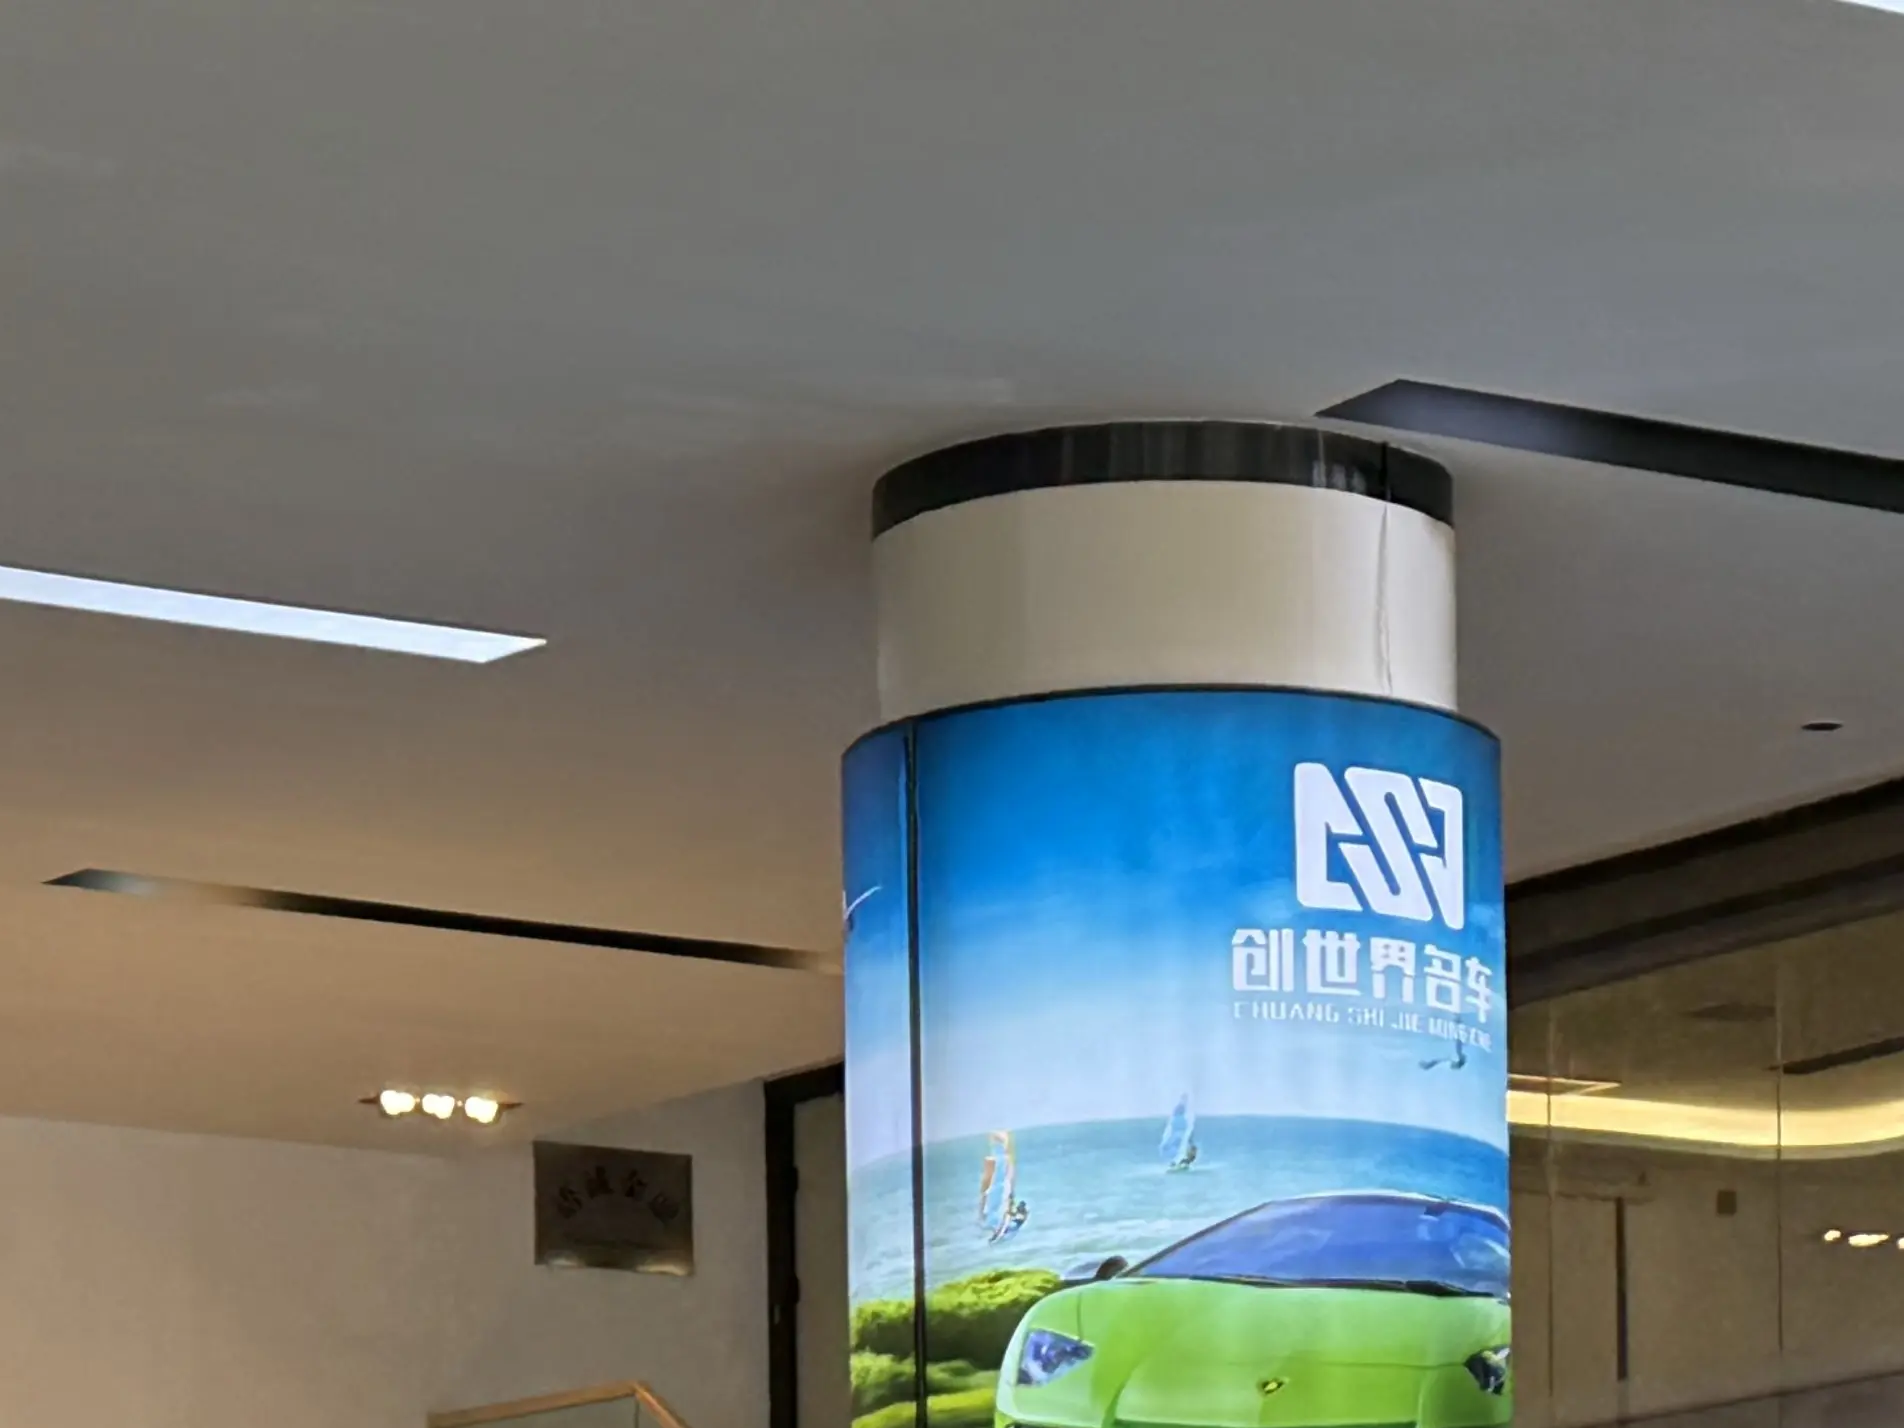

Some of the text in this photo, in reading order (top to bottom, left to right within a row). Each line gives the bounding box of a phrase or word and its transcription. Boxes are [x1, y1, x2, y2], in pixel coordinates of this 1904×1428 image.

[1231, 928, 1493, 1023] 创世界名车
[1233, 1001, 1340, 1023] CHUANG
